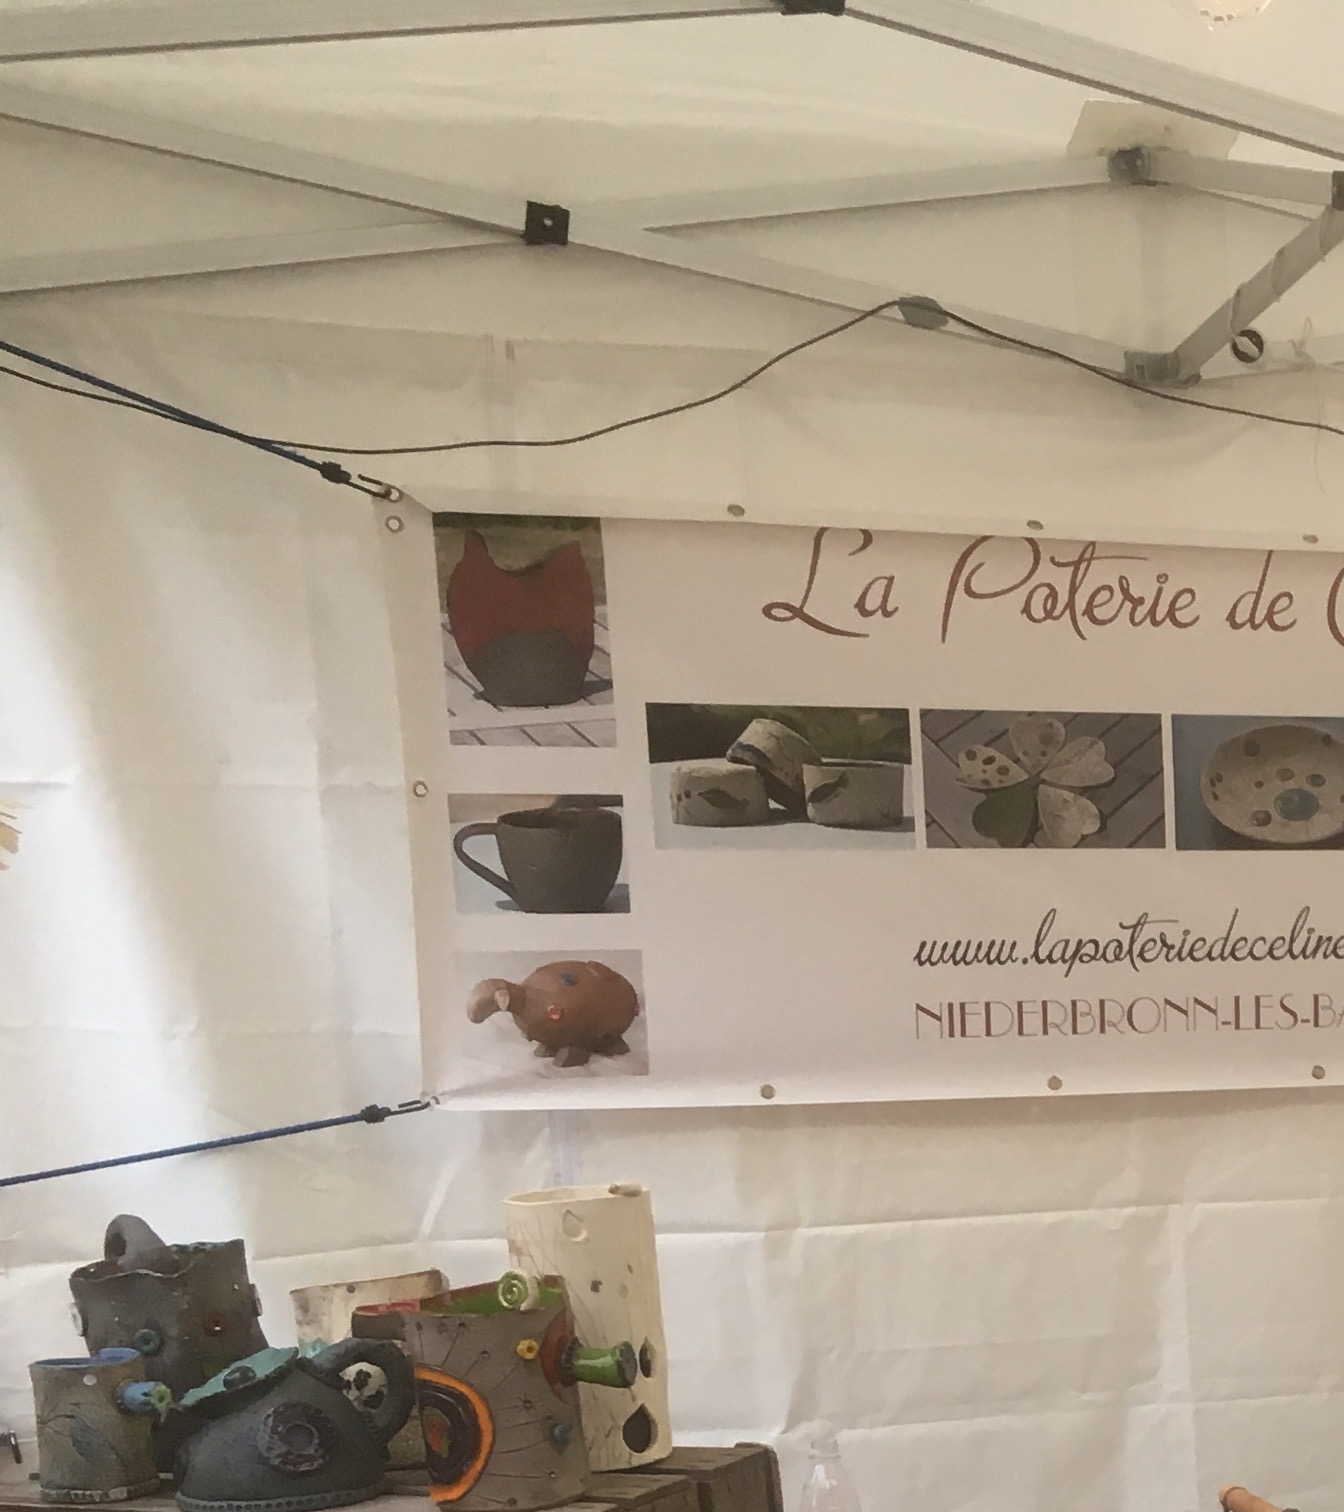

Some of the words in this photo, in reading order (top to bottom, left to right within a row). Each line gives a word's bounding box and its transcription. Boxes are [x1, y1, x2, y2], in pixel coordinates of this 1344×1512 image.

[762, 527, 899, 638] La
[941, 535, 1200, 643] Poterie
[1225, 550, 1297, 632] de
